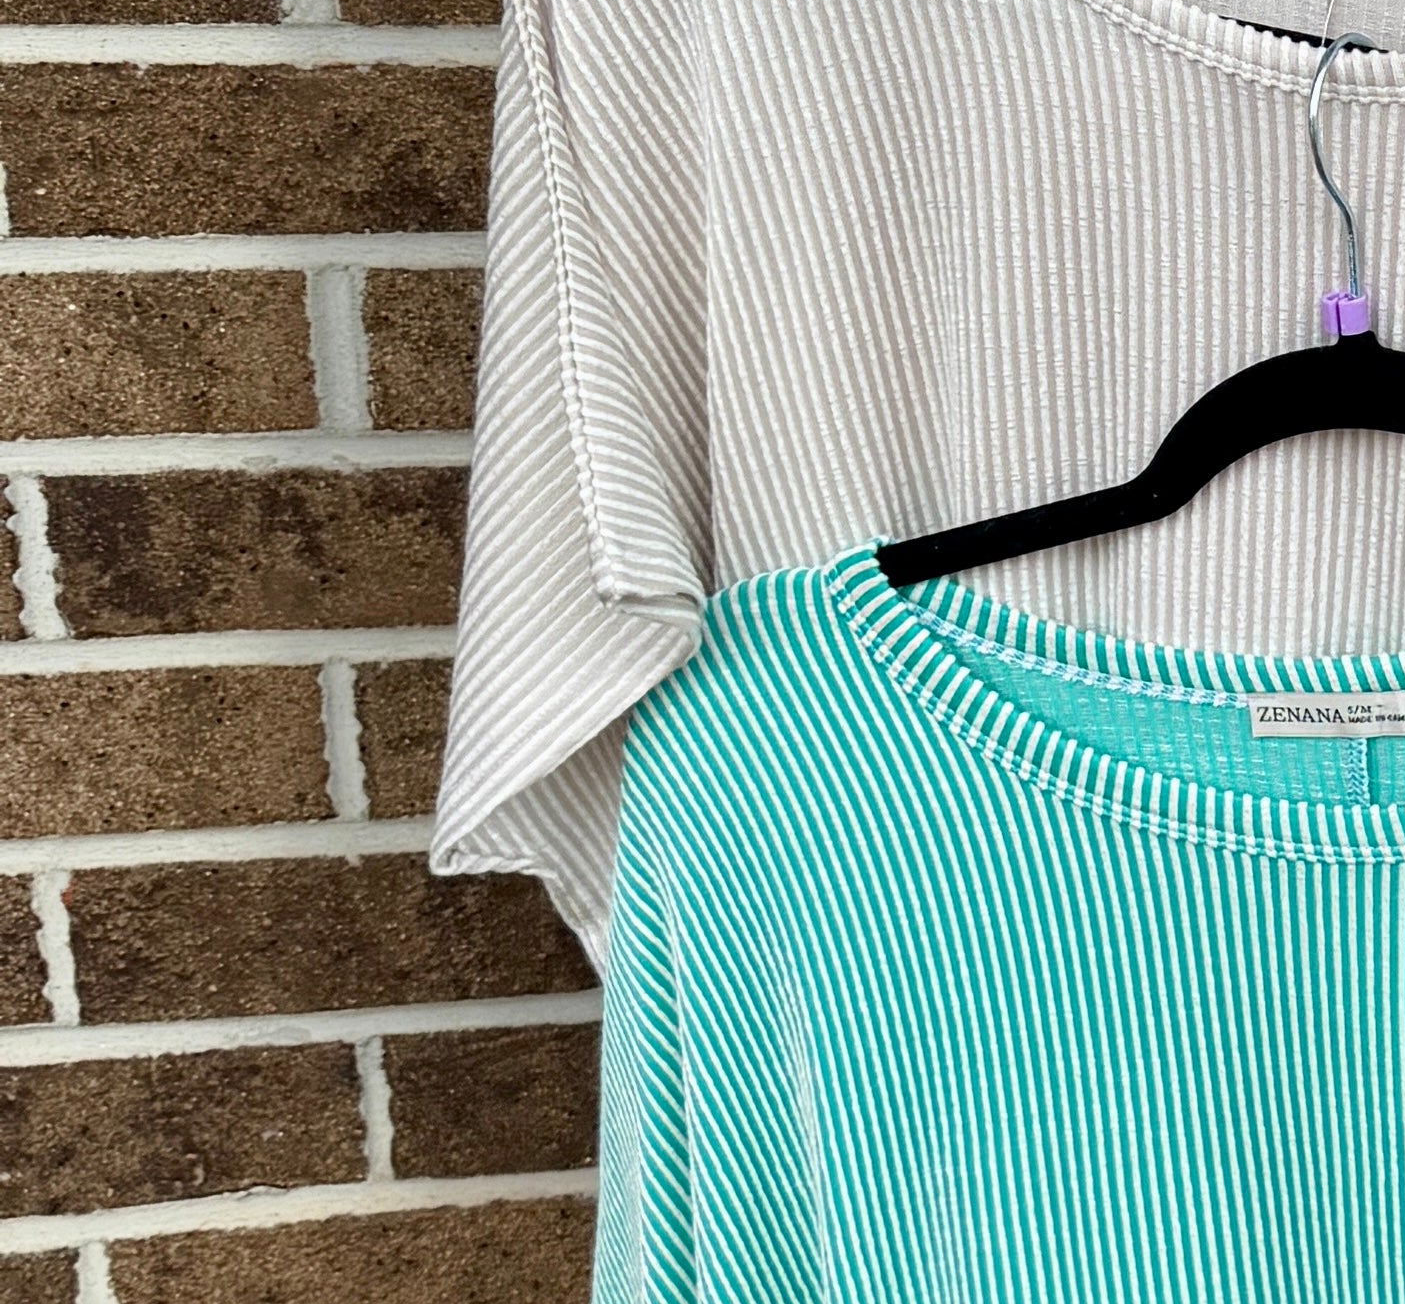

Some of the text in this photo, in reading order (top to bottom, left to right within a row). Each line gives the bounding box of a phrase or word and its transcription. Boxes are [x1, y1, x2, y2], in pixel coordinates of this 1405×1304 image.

[1347, 705, 1372, 714] S/M
[1256, 706, 1346, 724] ZENANA
[1348, 715, 1372, 723] MADE
